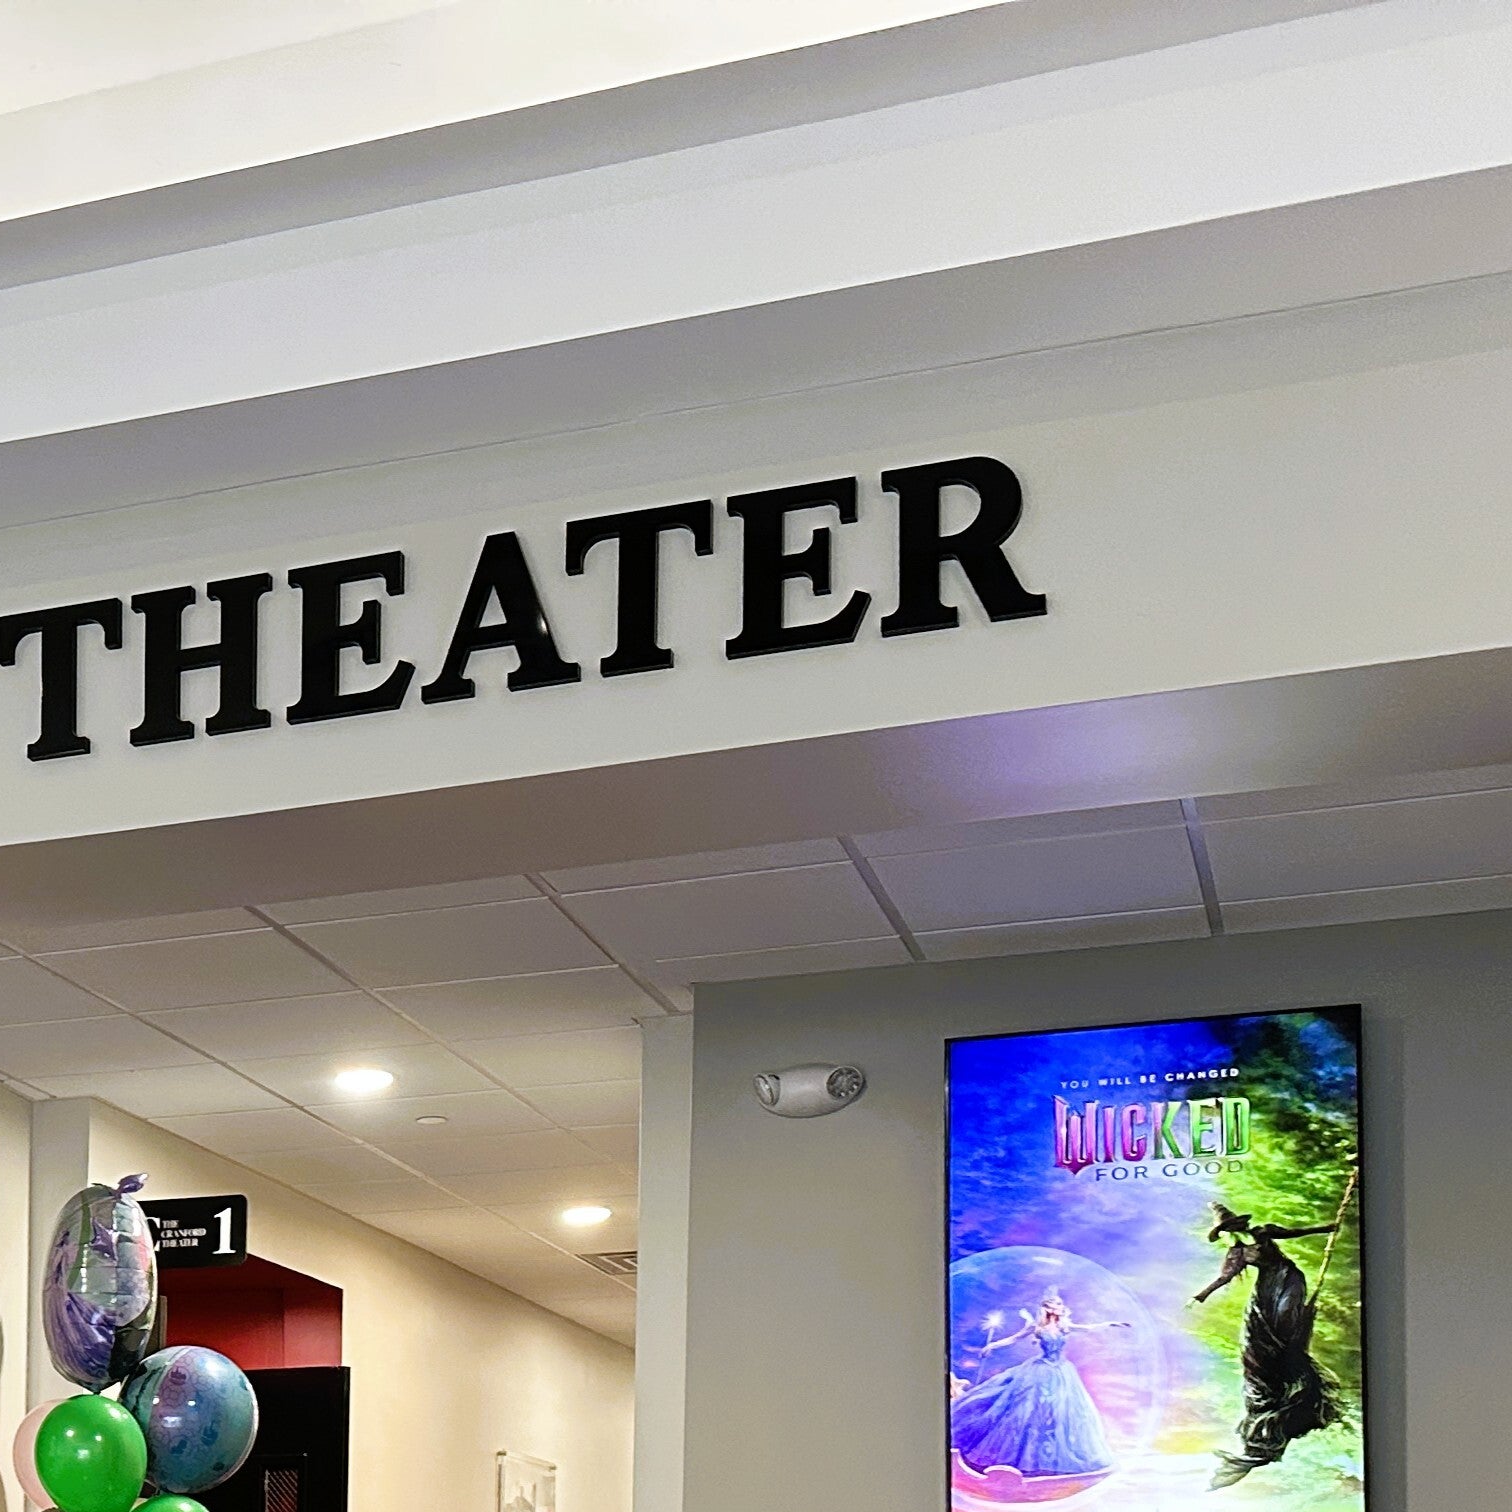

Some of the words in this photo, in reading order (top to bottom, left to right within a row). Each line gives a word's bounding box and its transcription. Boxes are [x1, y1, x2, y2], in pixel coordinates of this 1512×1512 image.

[1060, 1080, 1089, 1089] YOU
[1098, 1077, 1131, 1086] WILL
[1140, 1074, 1156, 1083] BE
[1165, 1068, 1240, 1082] CHANGED
[1053, 1095, 1251, 1175] WICKED
[1096, 1166, 1148, 1181] FOR
[1163, 1160, 1243, 1177] GOOD
[161, 1228, 207, 1238] CRANFORD
[212, 1207, 237, 1254] 1
[162, 1238, 199, 1248] THEATER
